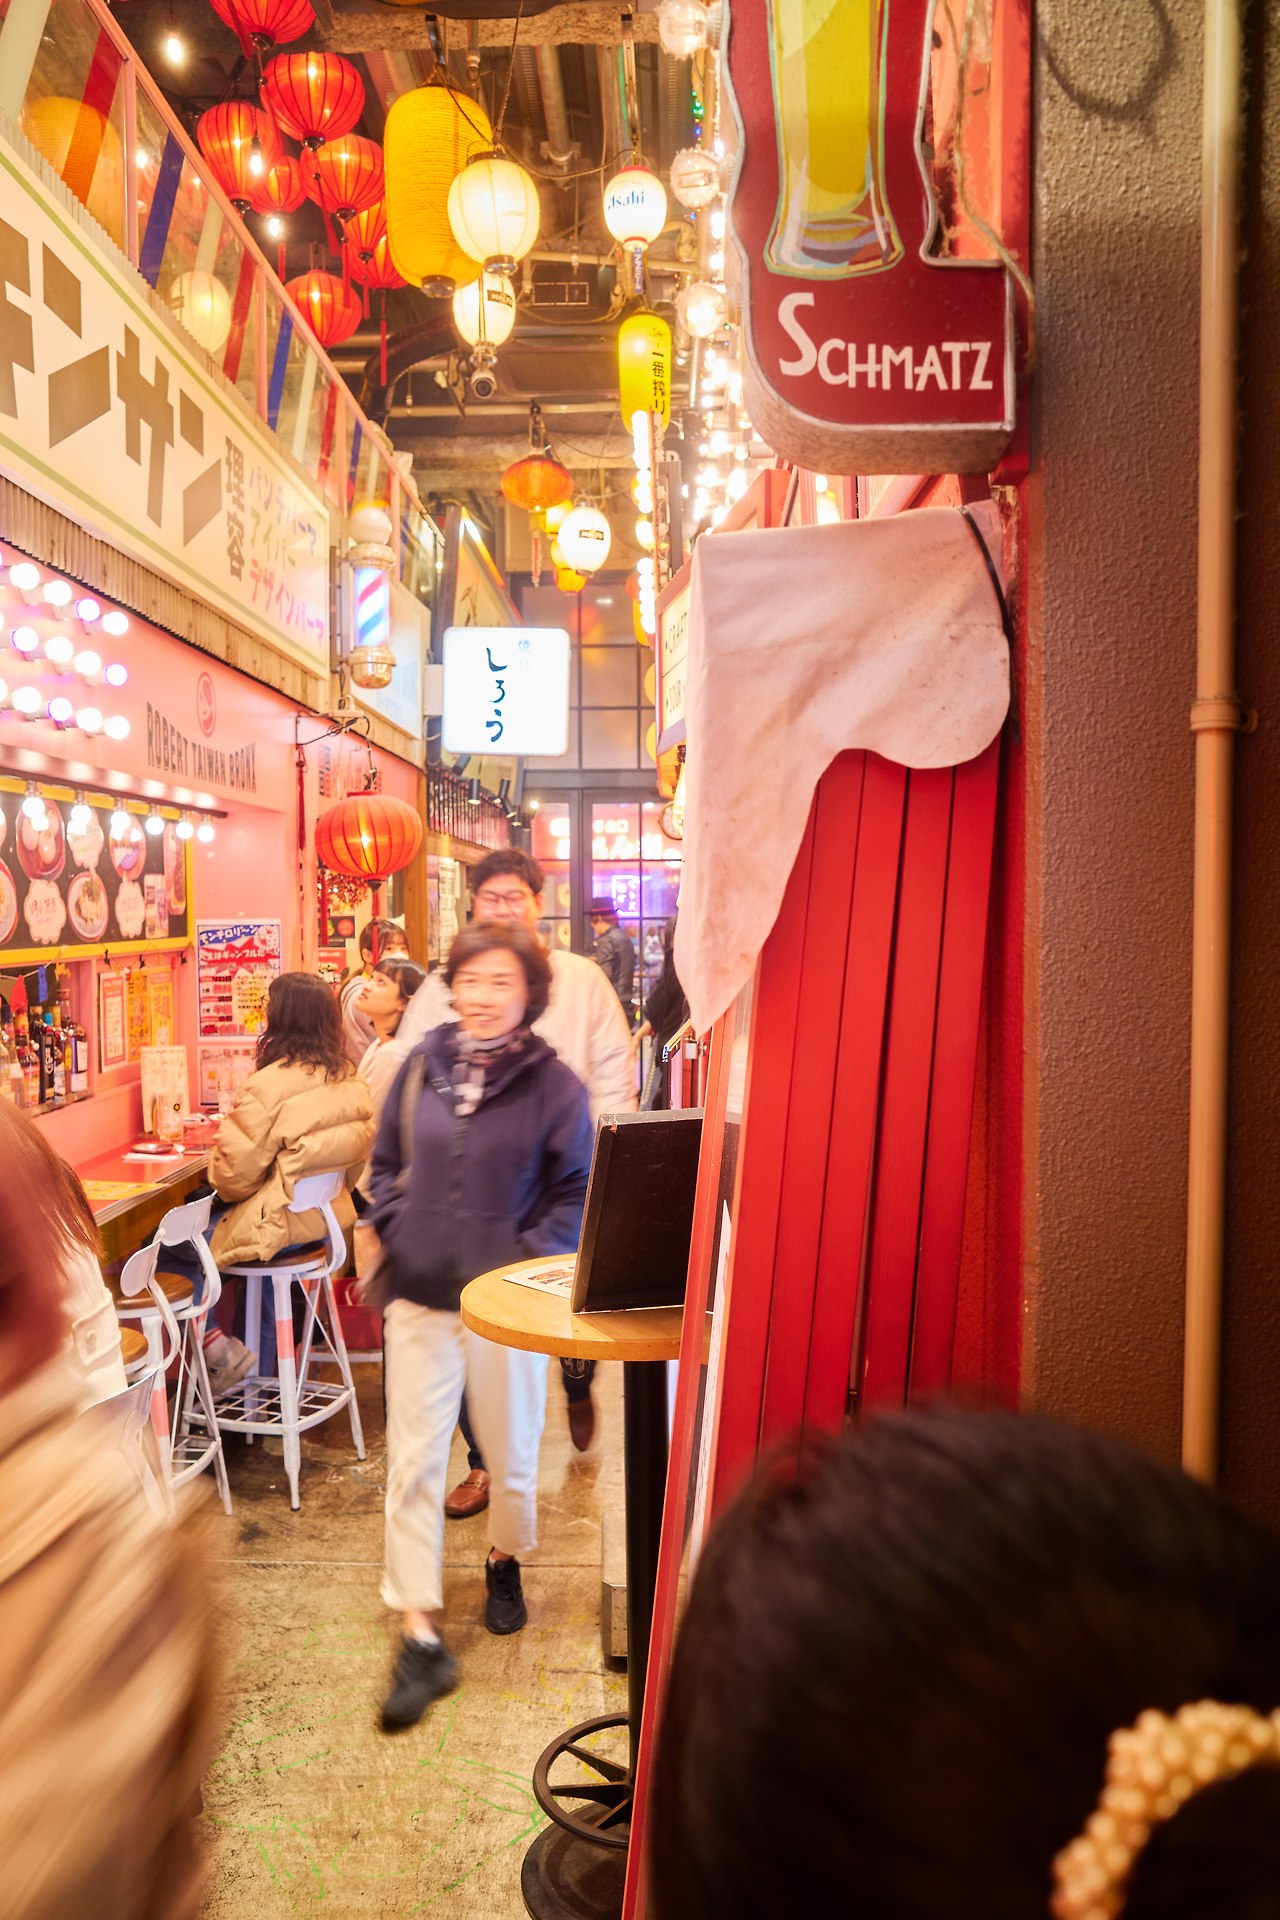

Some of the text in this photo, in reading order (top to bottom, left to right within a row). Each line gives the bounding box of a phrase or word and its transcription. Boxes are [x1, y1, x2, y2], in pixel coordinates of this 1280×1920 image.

[607, 190, 645, 211] Asahi
[225, 435, 245, 582] 理容
[250, 557, 325, 648] デザインパーマ
[486, 647, 508, 743] しろう
[147, 701, 188, 777] ROBERT
[191, 742, 226, 787] TAIWAN
[229, 741, 257, 795] BRONX
